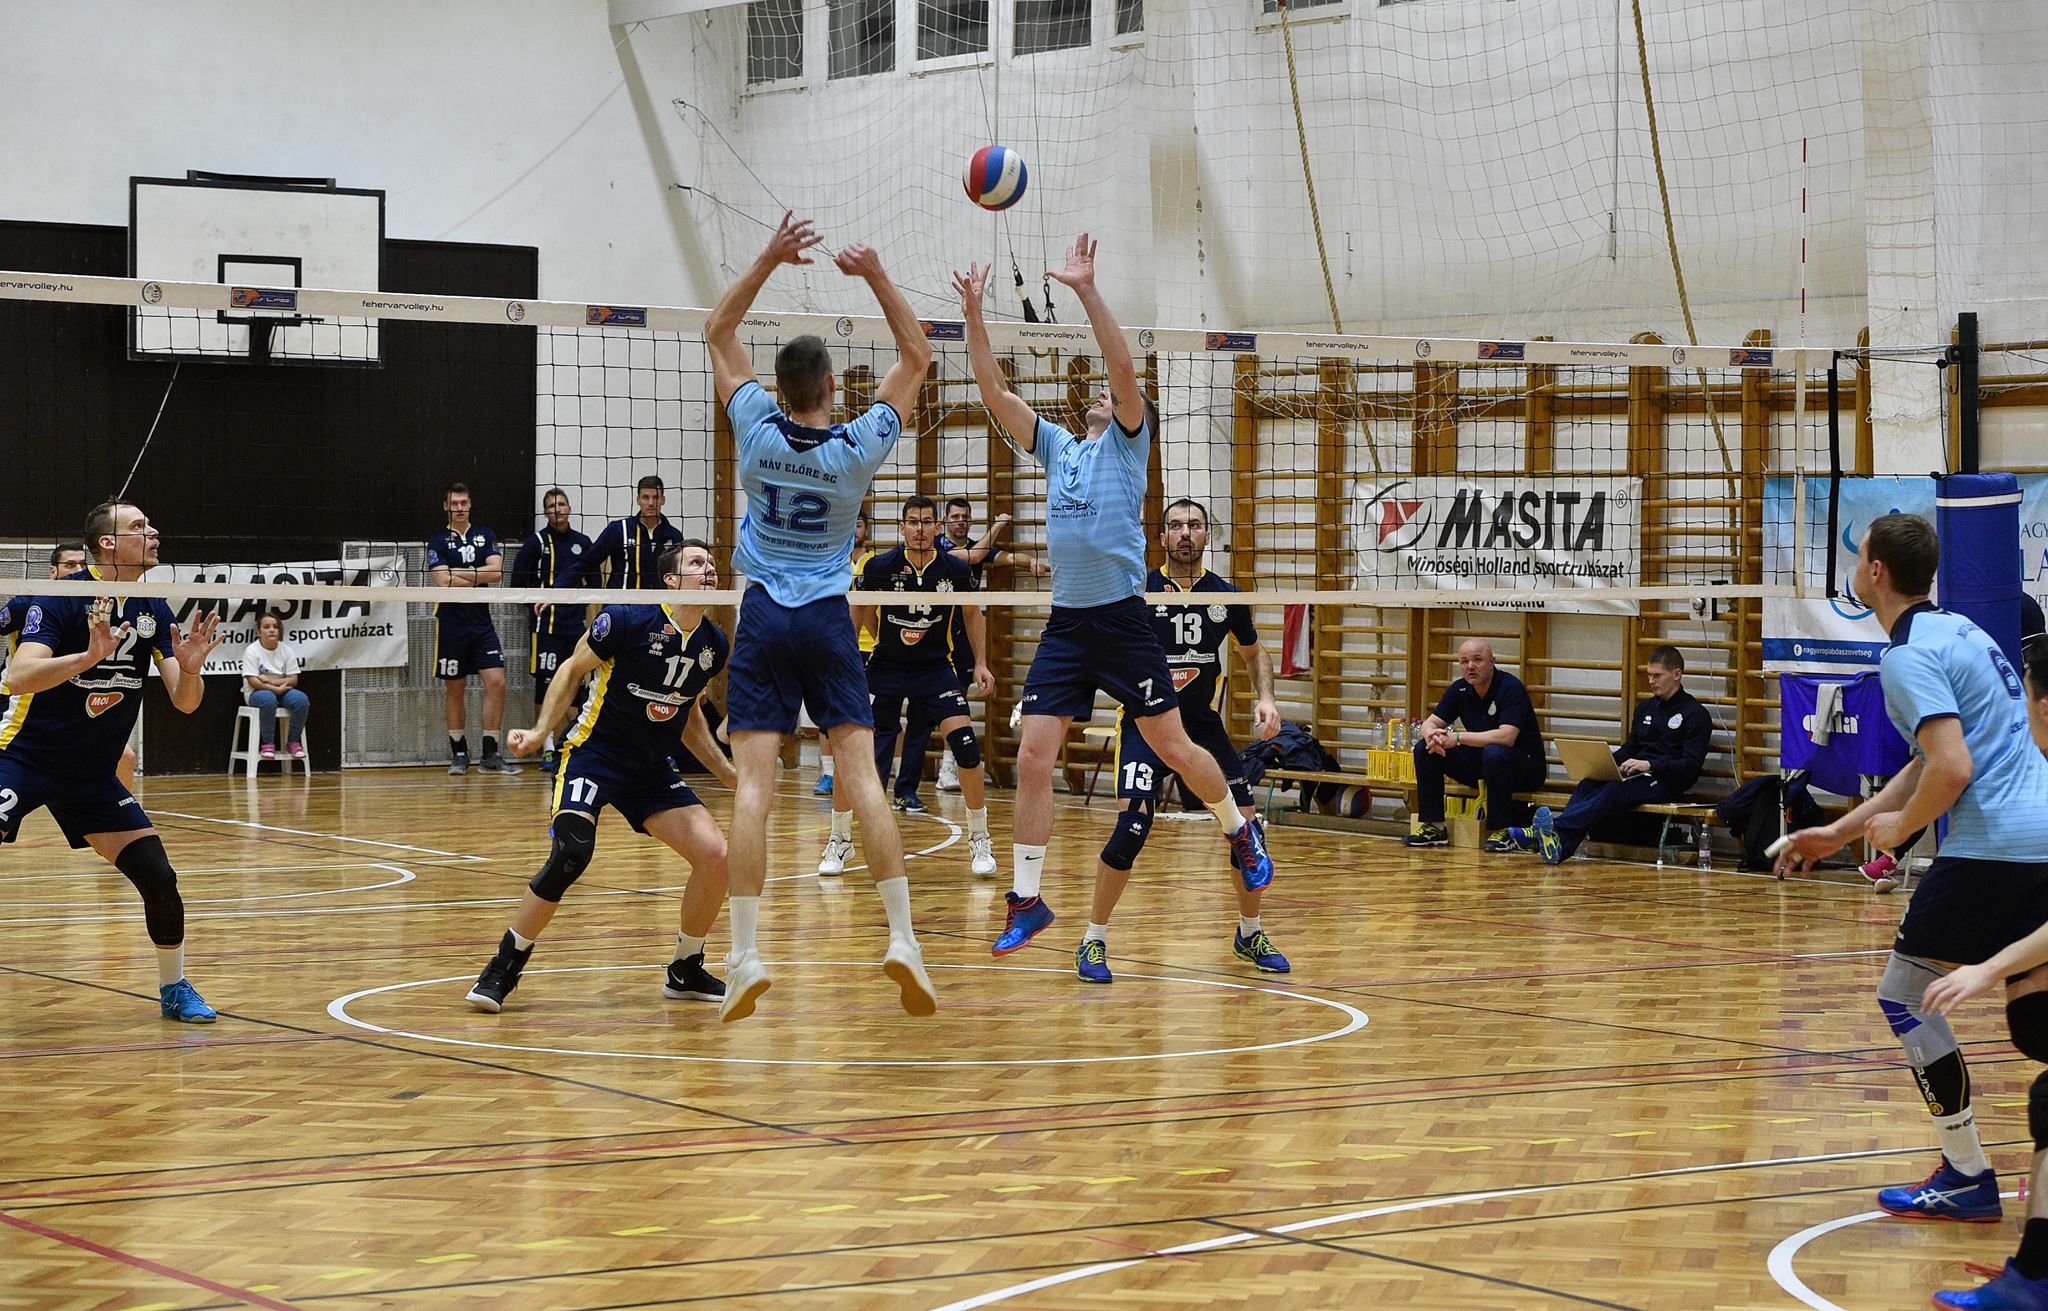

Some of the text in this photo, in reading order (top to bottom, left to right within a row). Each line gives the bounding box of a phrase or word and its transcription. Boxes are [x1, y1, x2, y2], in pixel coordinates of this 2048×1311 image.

[0, 281, 73, 291] ervarvolley.hu
[362, 300, 444, 311] fehervarvolley.hu
[1019, 331, 1087, 340] fehervarvolley.hu
[1306, 341, 1368, 350] fehervarvolley.hu
[759, 458, 781, 470] MÁV
[761, 481, 831, 534] 12
[1437, 489, 1606, 551] MASITA
[457, 544, 476, 564] 18
[1407, 555, 1624, 579] Minőségi Holland sportruházat
[176, 569, 371, 622] MASITA
[289, 622, 394, 644] sportruházat
[1170, 613, 1202, 645] 13
[439, 658, 459, 676] 18
[662, 655, 695, 688] 17
[1987, 646, 2022, 700] 6
[1138, 678, 1153, 700] 7
[1123, 762, 1154, 791] 13
[568, 777, 599, 806] 17
[0, 787, 19, 822] 2
